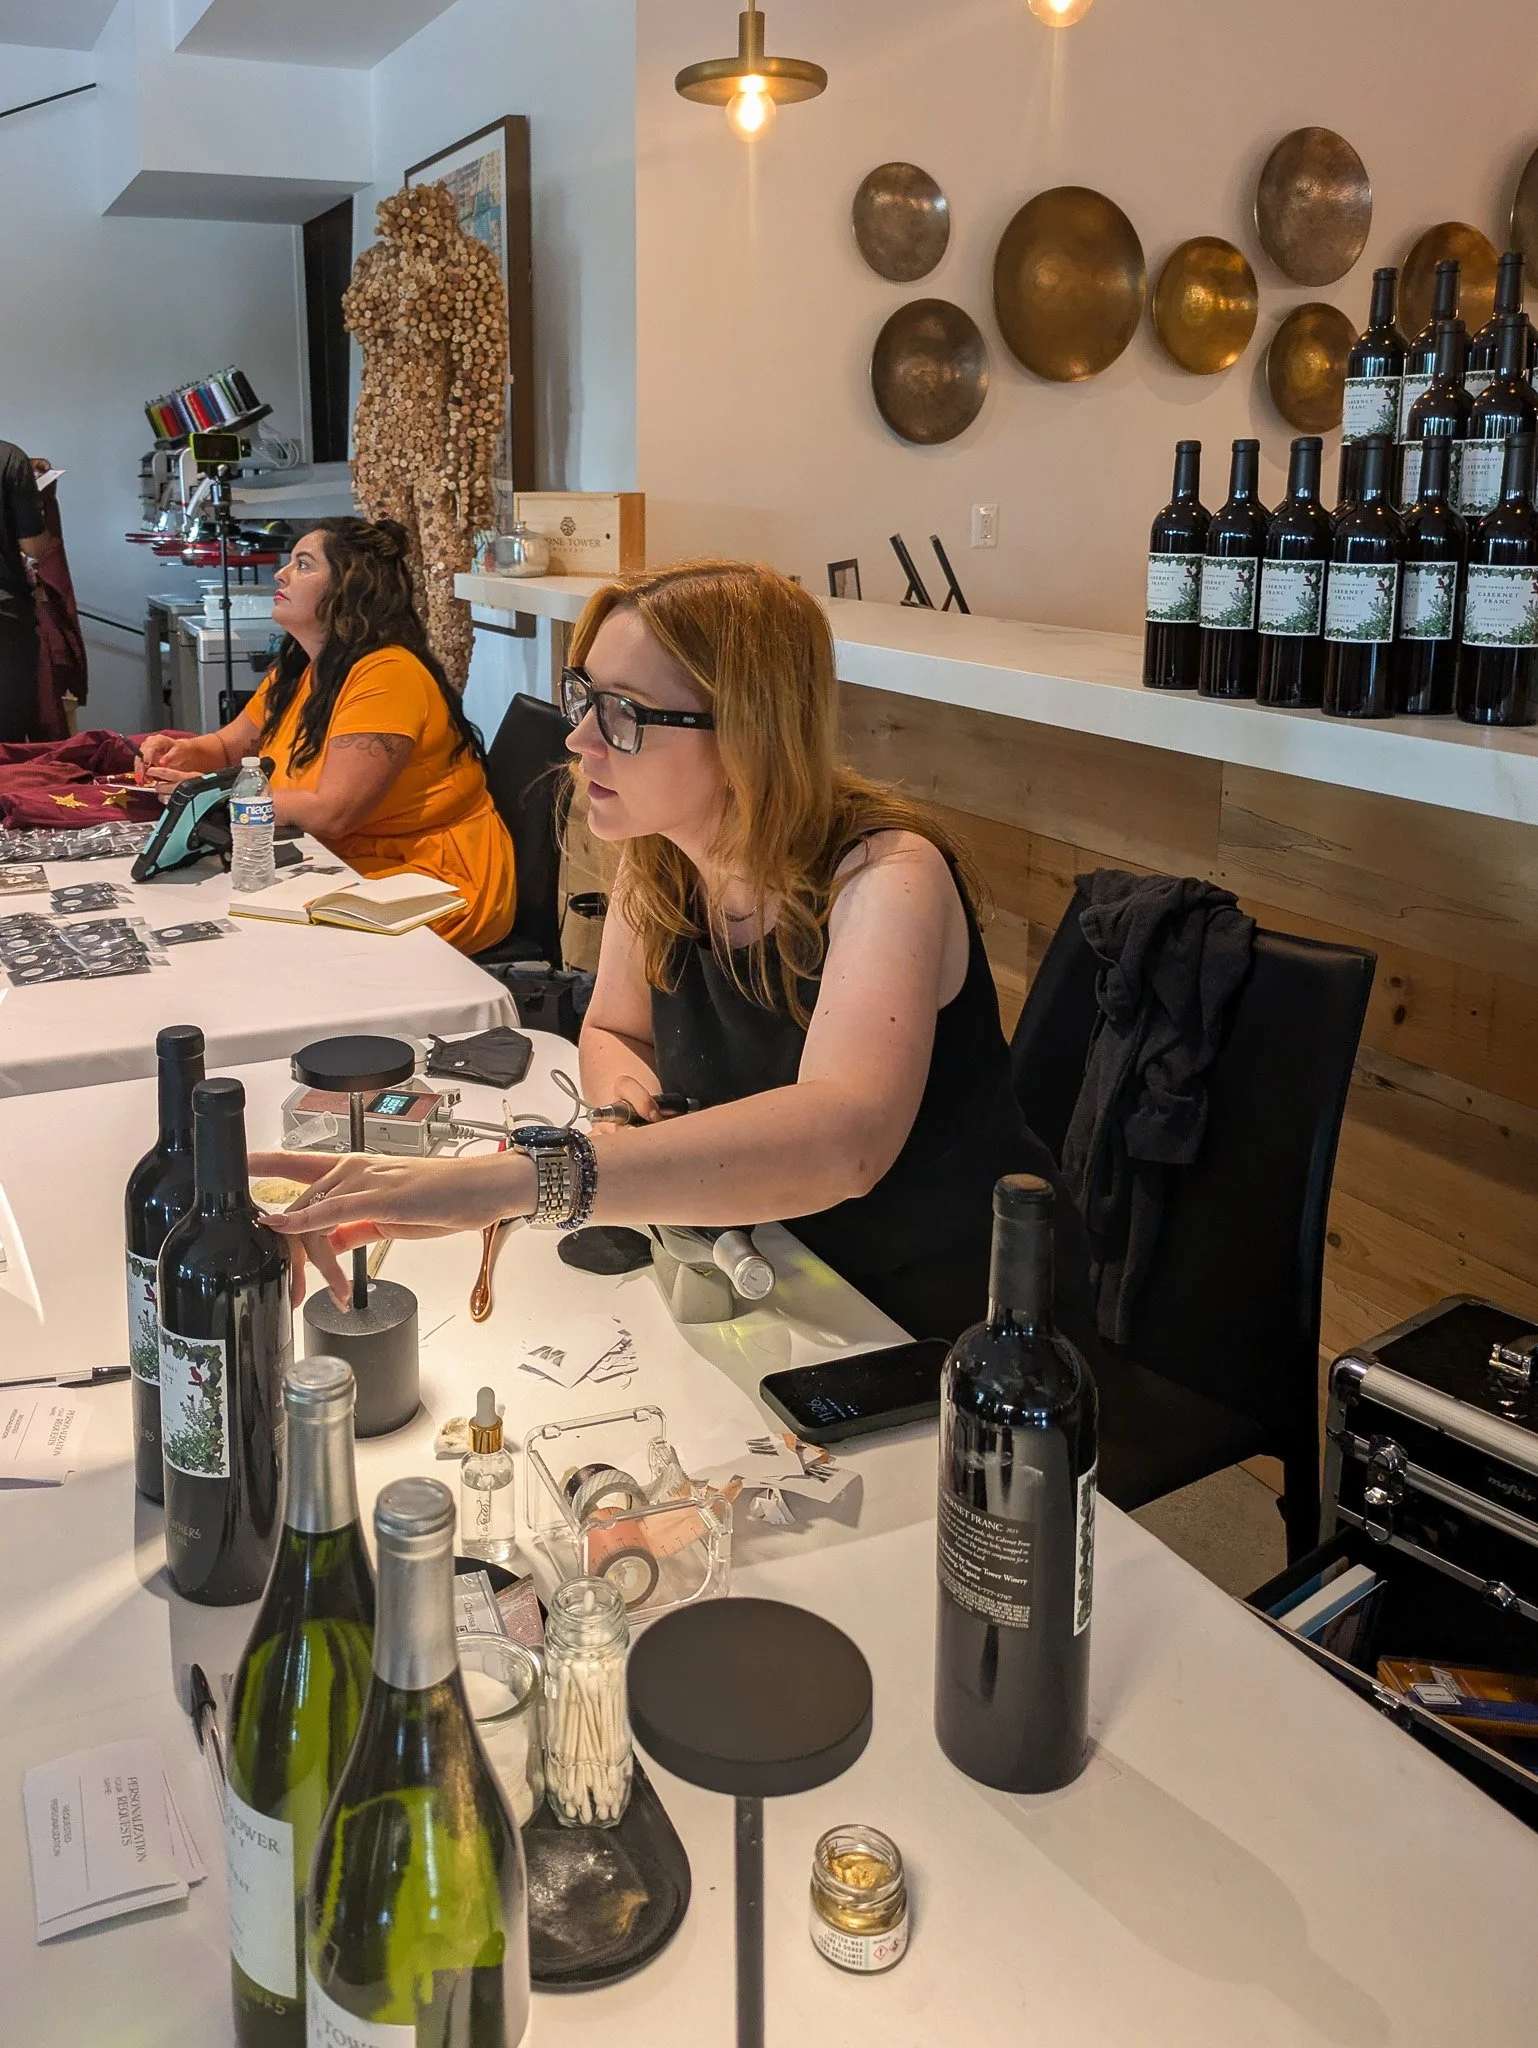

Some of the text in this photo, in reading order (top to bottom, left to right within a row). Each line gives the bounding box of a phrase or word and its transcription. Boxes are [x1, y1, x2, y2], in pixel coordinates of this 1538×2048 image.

[569, 538, 601, 547] TOWER
[971, 1513, 1003, 1532] FRANC
[995, 1536, 1017, 1546] Cabernet
[1003, 1547, 1023, 1555] wrapped
[960, 1564, 980, 1580] Virginia
[983, 1568, 1002, 1580] Tower
[1004, 1574, 1027, 1586] Winery
[464, 1602, 475, 1629] Clarissa
[103, 1777, 112, 1794] NAME
[114, 1776, 123, 1793] YOUR
[50, 1799, 62, 1857] PERSONALIZATION
[62, 1805, 72, 1843] REQUESTED
[117, 1796, 132, 1846] REQUESTS
[128, 1776, 148, 1862] PERSONALIZATION
